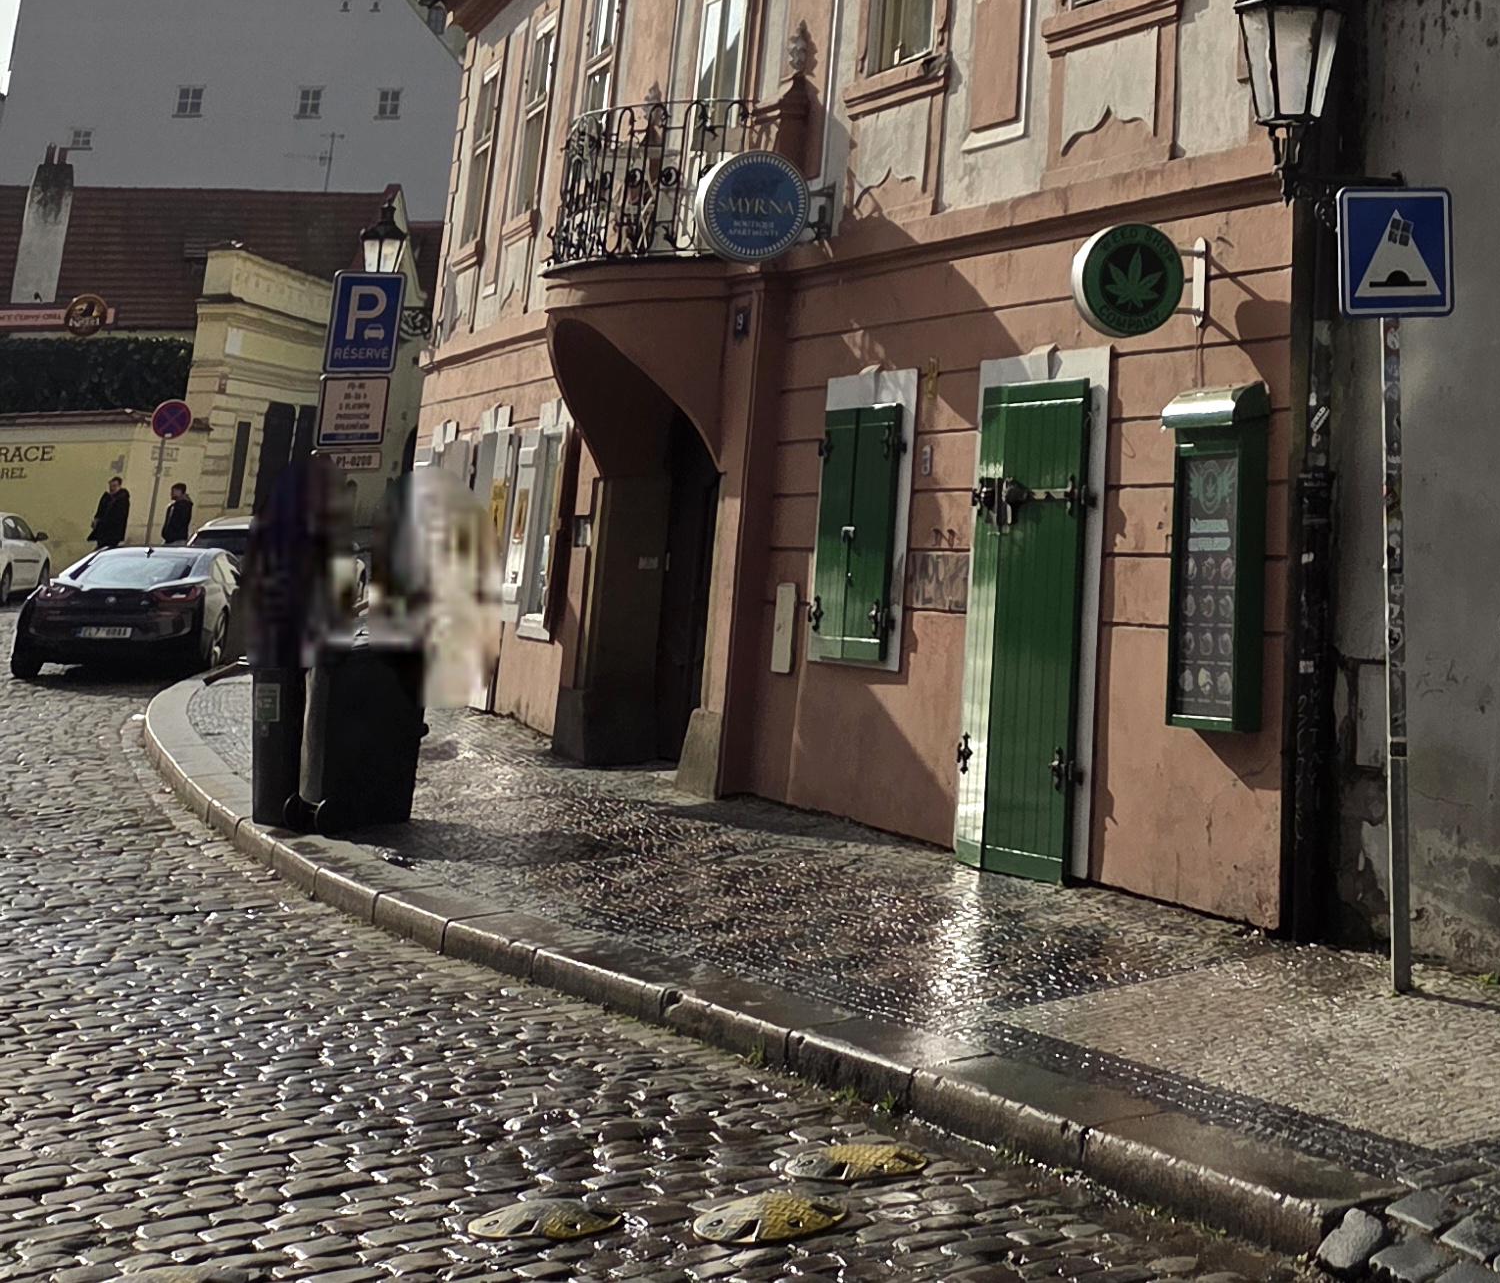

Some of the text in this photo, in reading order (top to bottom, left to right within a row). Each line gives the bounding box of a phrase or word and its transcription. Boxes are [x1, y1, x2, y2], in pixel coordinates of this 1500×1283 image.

[716, 197, 794, 215] SMYRNA
[1099, 228, 1175, 262] WEED SHOP
[345, 285, 387, 340] P
[1100, 304, 1161, 327] COMPANY
[334, 344, 389, 359] RÉSERVÉ
